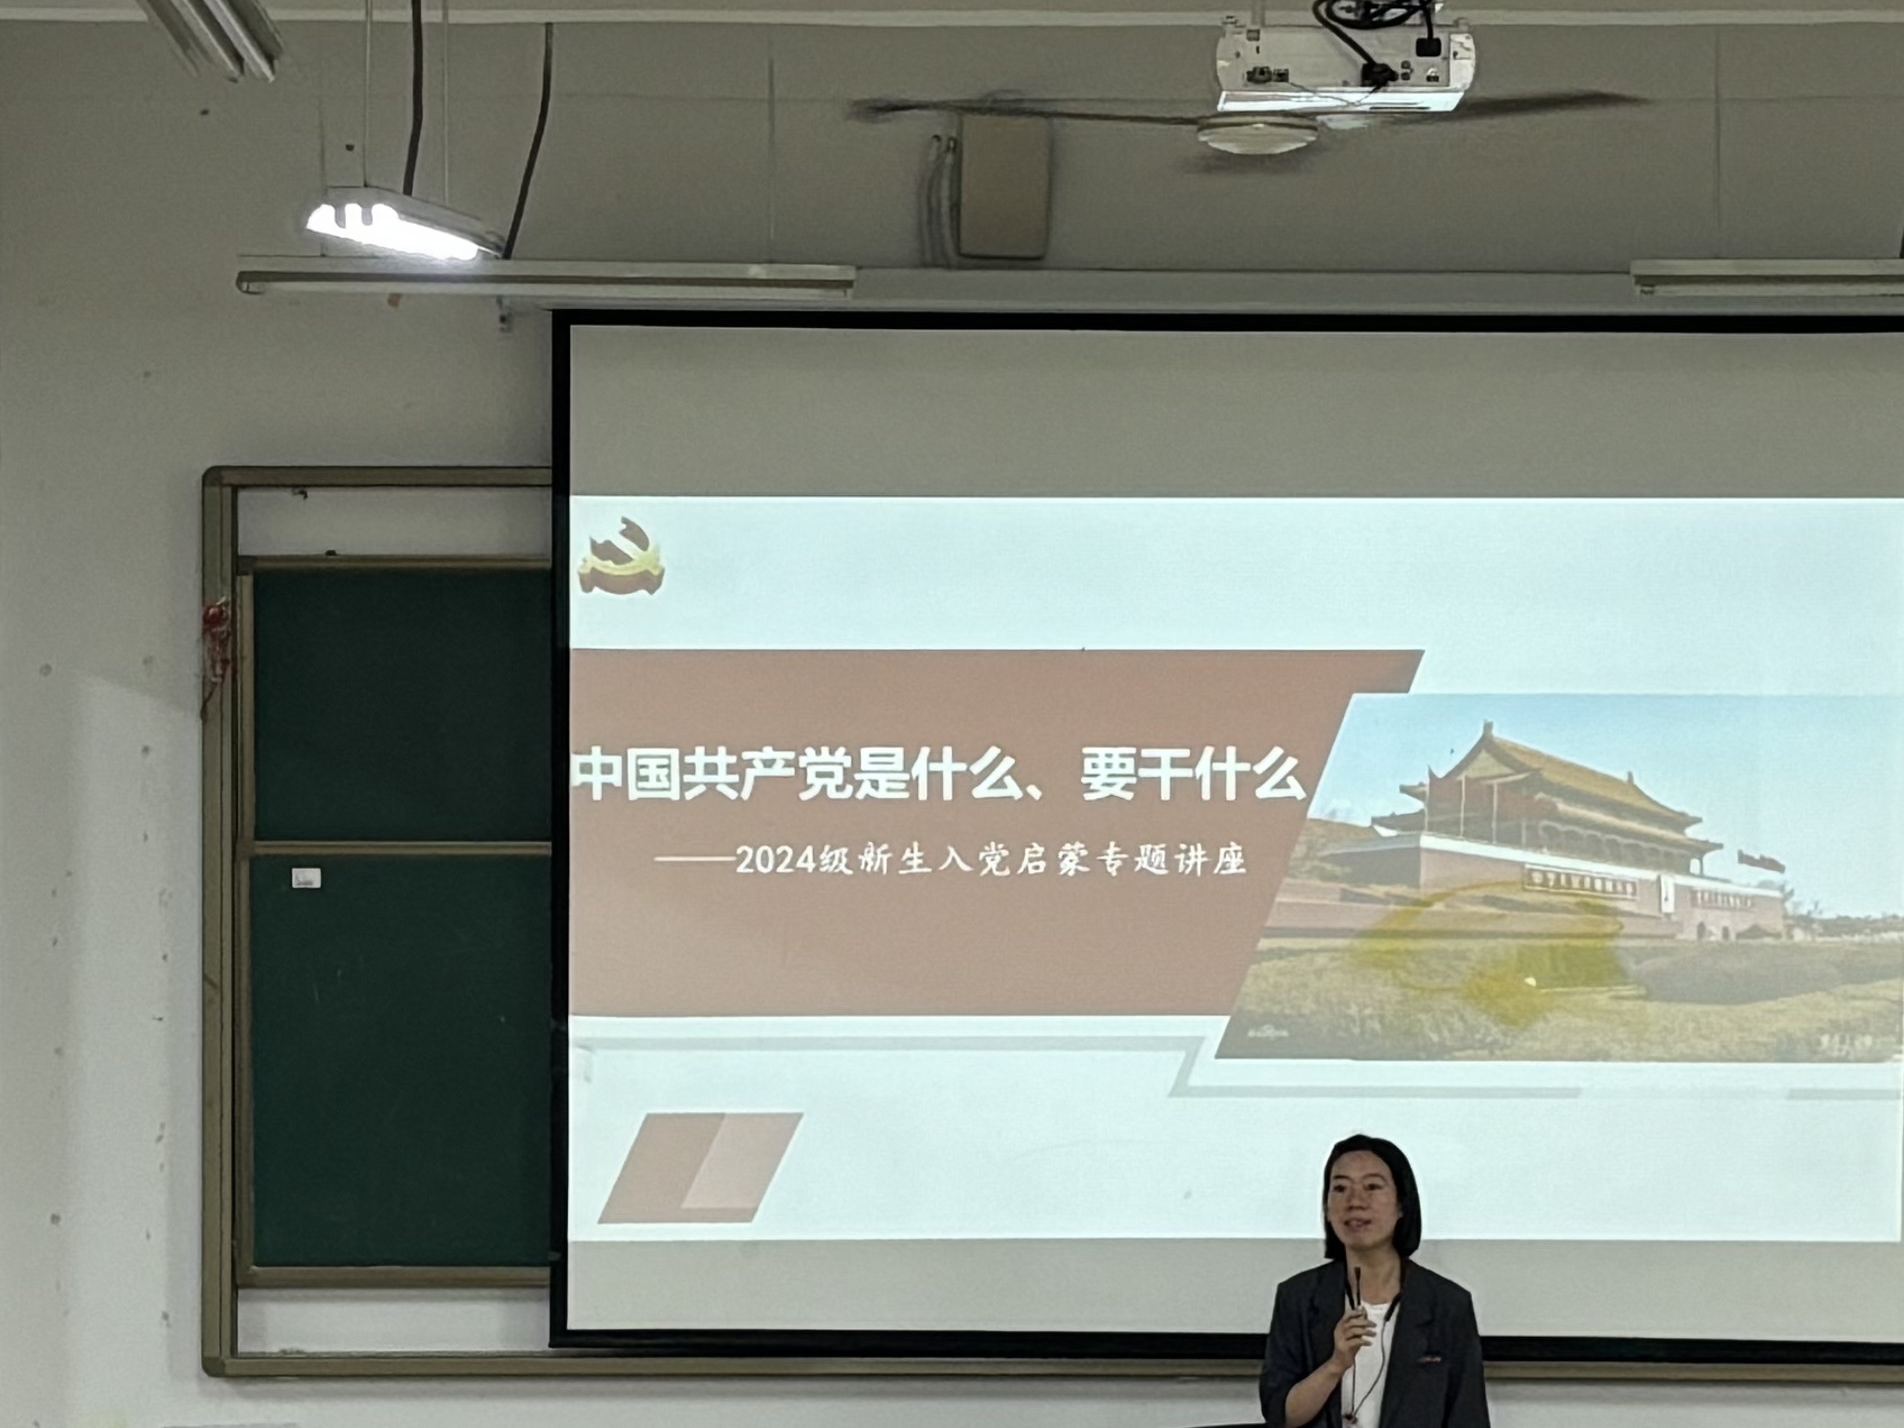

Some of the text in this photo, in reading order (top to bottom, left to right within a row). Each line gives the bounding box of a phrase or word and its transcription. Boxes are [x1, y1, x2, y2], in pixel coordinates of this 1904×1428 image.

[571, 745, 1308, 803] 中国共产党是什么、要干什么
